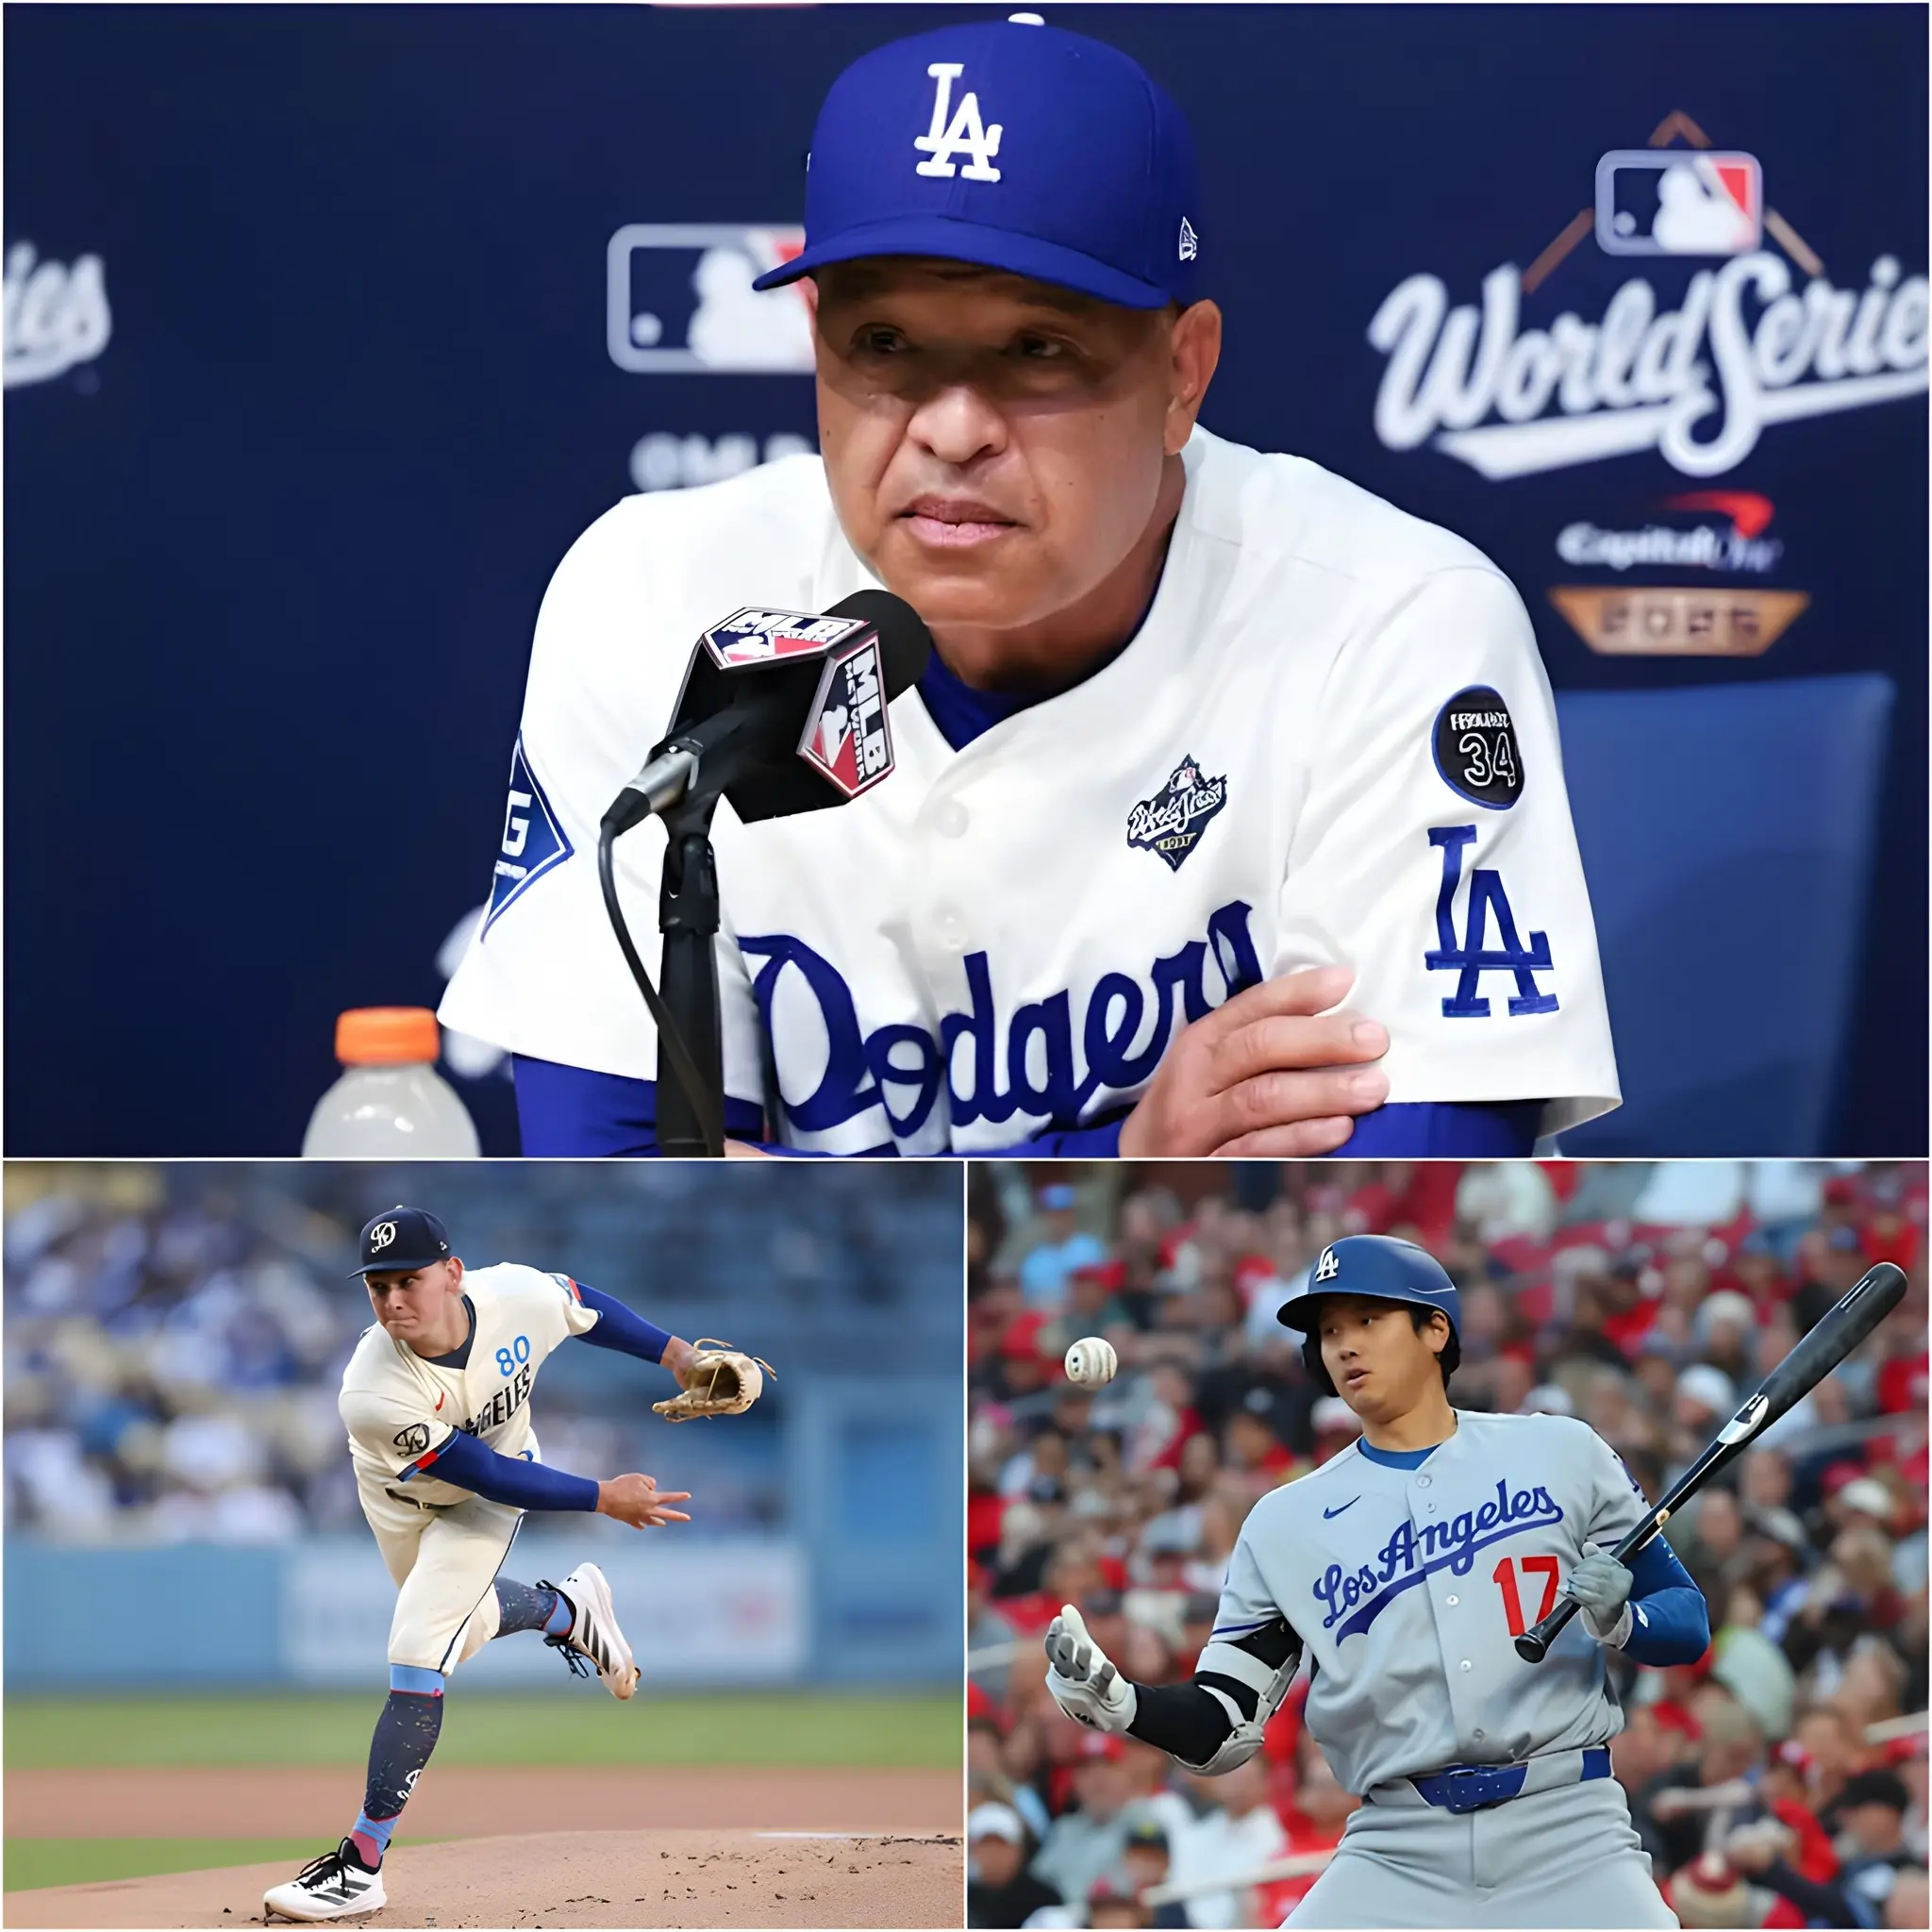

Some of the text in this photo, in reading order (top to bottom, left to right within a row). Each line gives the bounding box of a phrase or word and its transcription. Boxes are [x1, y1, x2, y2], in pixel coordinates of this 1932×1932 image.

[914, 62, 1003, 183] LA
[1368, 262, 1719, 451] World
[852, 647, 888, 775] MLB
[1458, 732, 1516, 787] 34
[1424, 824, 1560, 1018] LA
[495, 1335, 531, 1377] 80
[1312, 1563, 1377, 1629] Los
[1377, 1478, 1564, 1583] Angeles
[1492, 1556, 1559, 1637] 17
